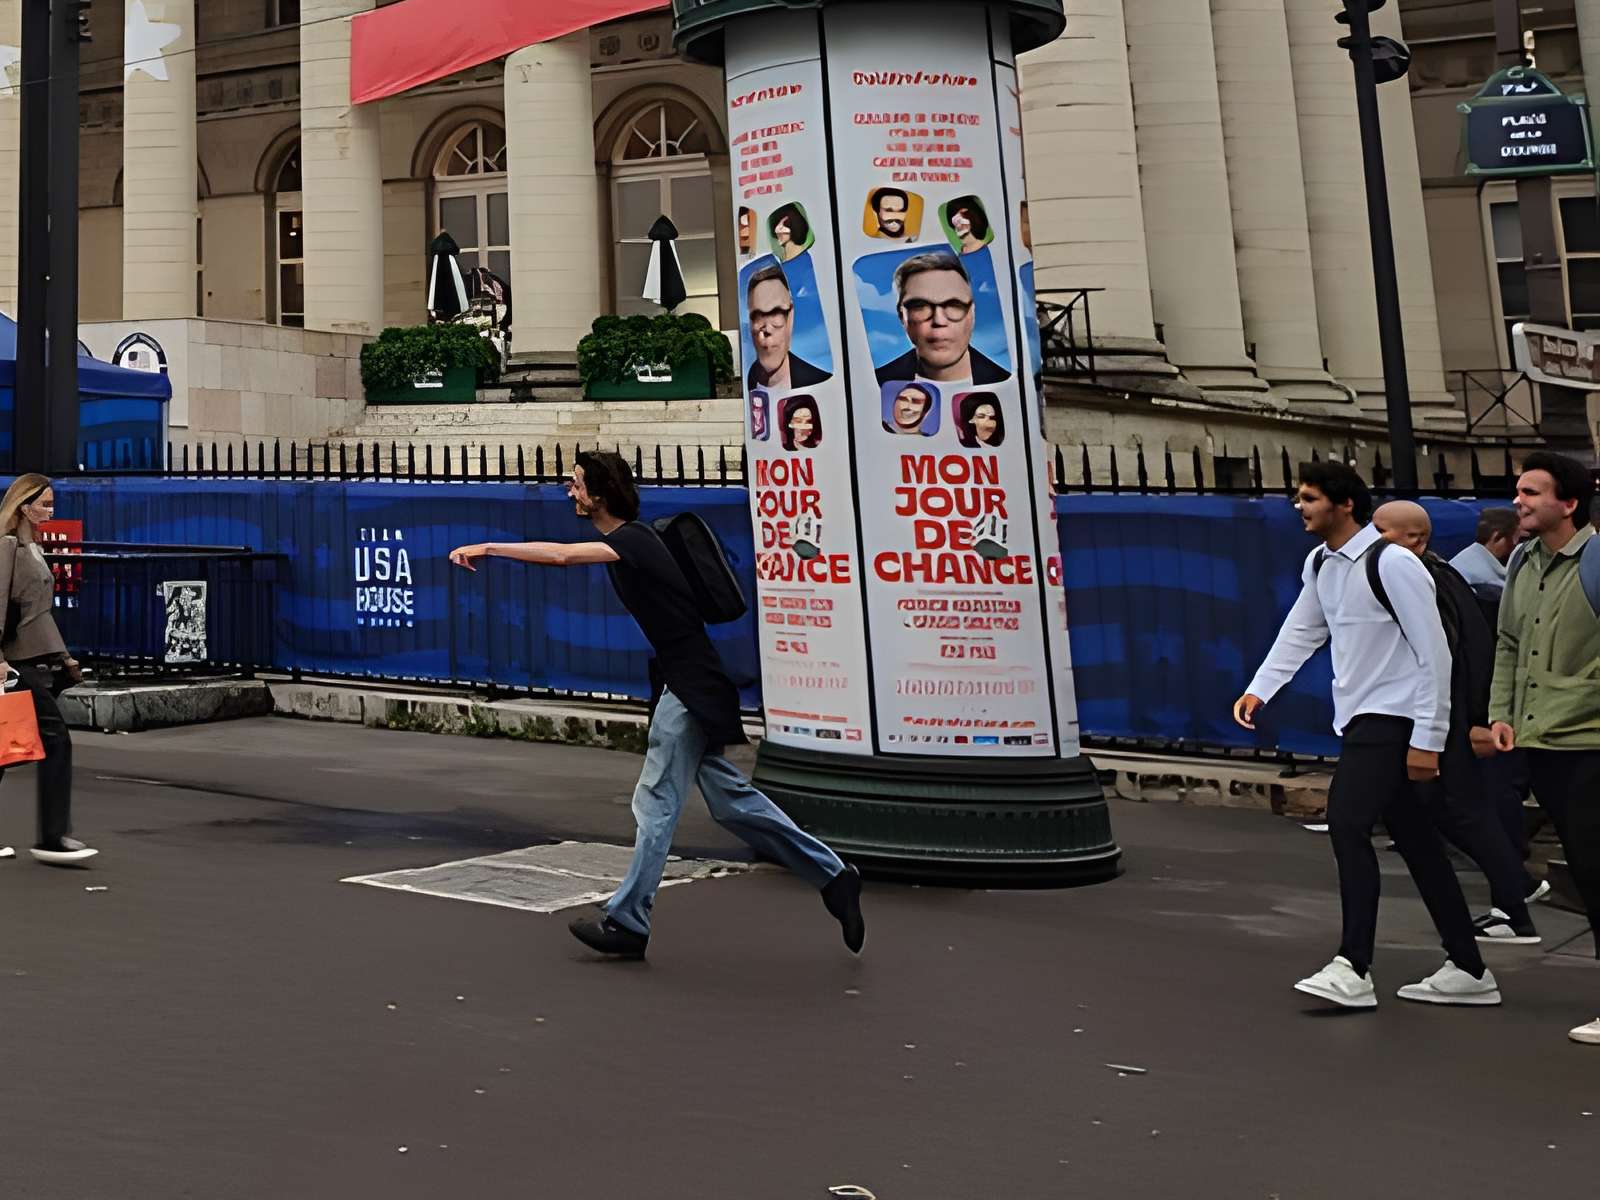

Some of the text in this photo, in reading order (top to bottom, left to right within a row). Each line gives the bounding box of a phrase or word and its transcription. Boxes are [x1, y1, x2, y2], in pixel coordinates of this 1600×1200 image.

[900, 454, 999, 485] MON
[755, 489, 822, 519] OUR
[894, 486, 1008, 519] JOUR
[761, 520, 793, 550] DE
[913, 519, 975, 551] DE
[354, 546, 413, 585] USA
[873, 551, 1033, 585] CHANCE
